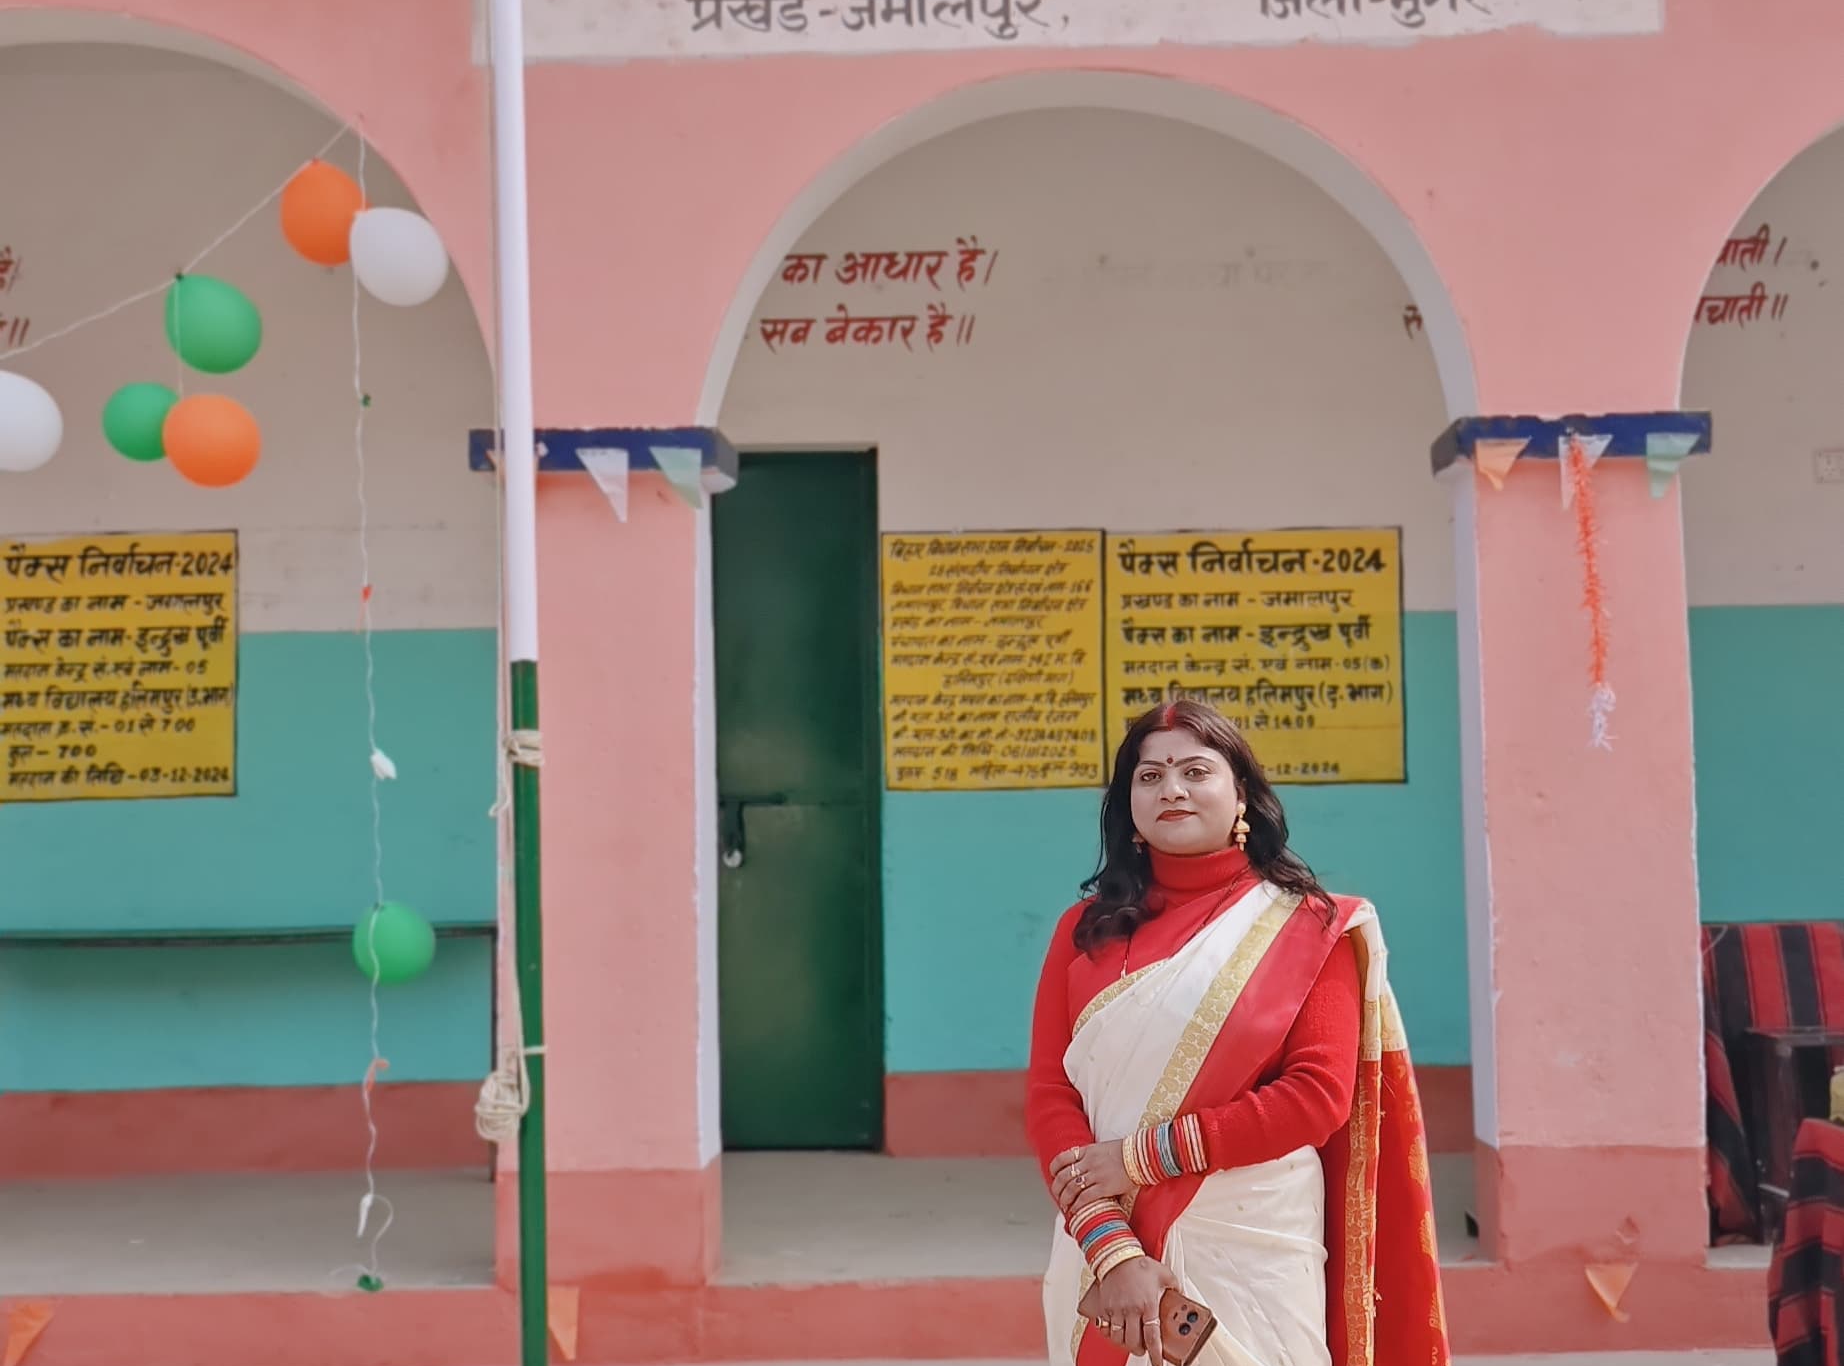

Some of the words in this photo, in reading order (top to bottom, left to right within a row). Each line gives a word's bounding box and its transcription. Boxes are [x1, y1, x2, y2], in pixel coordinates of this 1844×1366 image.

[781, 252, 828, 284] का
[834, 250, 949, 292] आधार
[760, 317, 817, 355] सब
[824, 302, 918, 353] बेकार
[60, 596, 81, 612] का
[86, 594, 130, 612] नाम
[1179, 593, 1198, 608] का
[1203, 591, 1240, 607] नाम
[1261, 589, 1354, 612] जमालपुर
[58, 628, 82, 648] का
[1172, 626, 1194, 644] का
[1202, 625, 1241, 643] नाम
[186, 659, 208, 676] 05
[1123, 660, 1179, 676] मतदान
[1184, 653, 1227, 676] केन्द्र
[2, 690, 41, 709] मध्य
[45, 684, 118, 712] विद्यालय
[1121, 685, 1162, 706] मध्य
[114, 719, 135, 734] 01
[138, 713, 154, 737] से
[1254, 709, 1272, 730] से
[58, 744, 98, 759] 700
[60, 765, 80, 784] की
